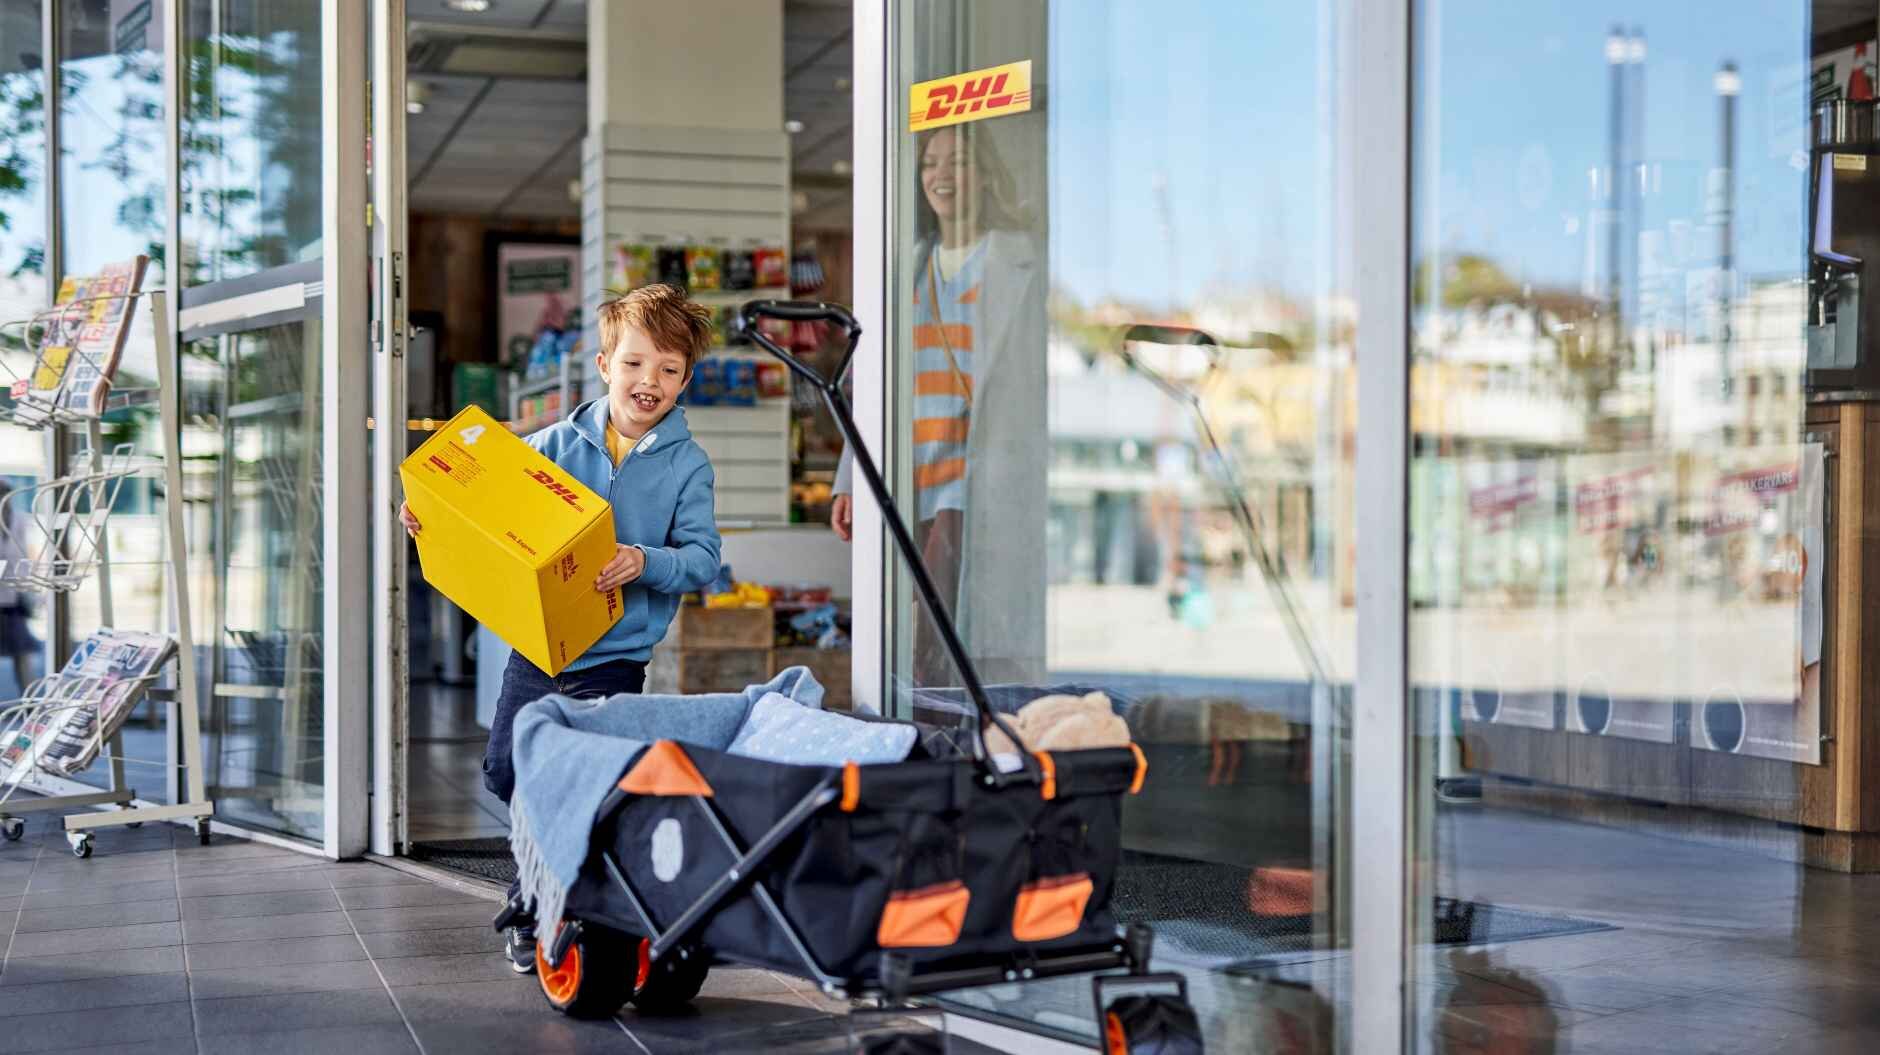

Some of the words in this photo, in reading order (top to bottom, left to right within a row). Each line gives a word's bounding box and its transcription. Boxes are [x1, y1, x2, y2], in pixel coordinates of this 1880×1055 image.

[926, 73, 1013, 120] DHL
[459, 424, 486, 446] 4
[532, 470, 579, 506] DHL
